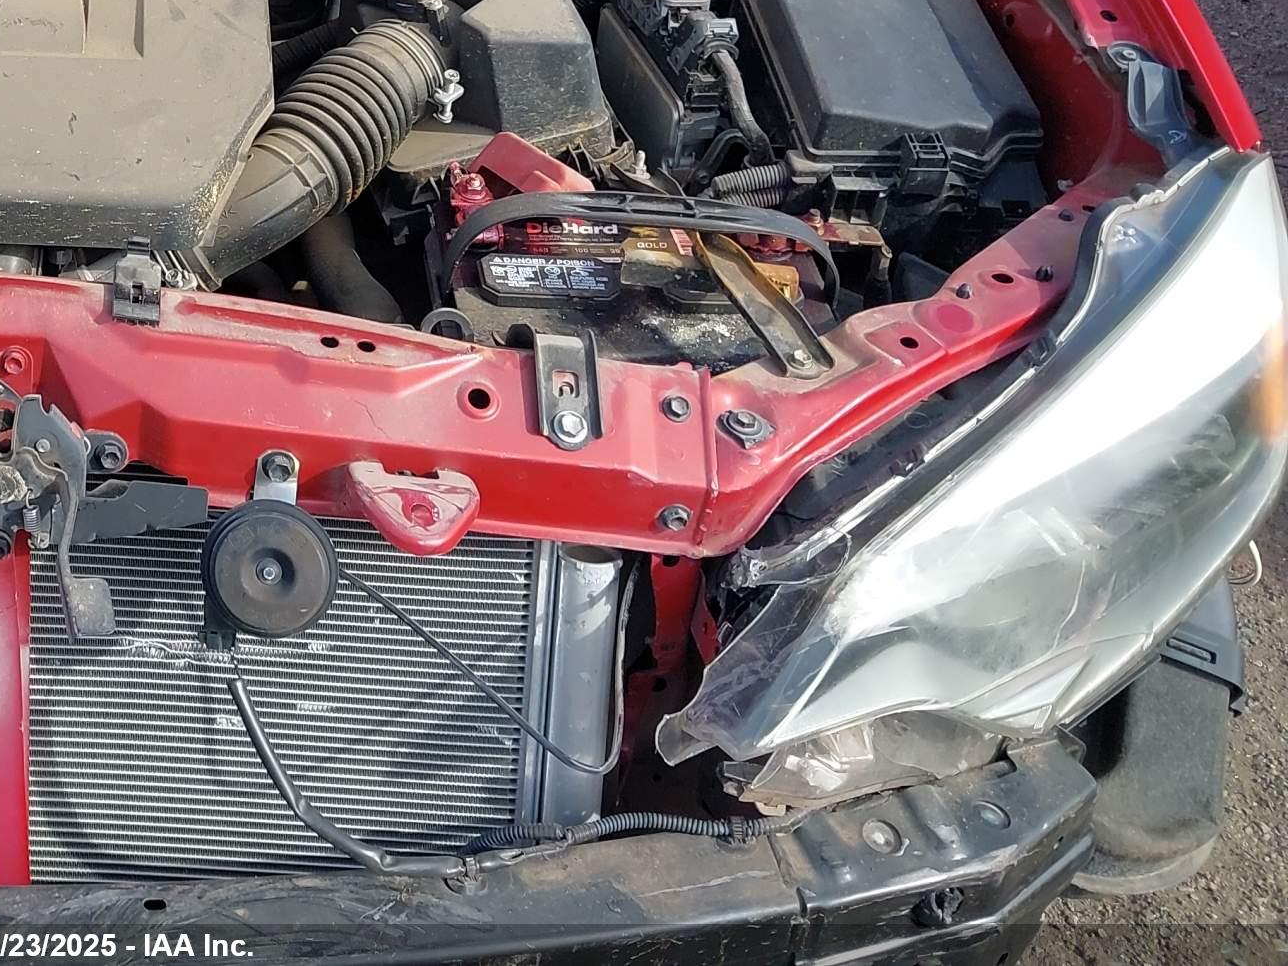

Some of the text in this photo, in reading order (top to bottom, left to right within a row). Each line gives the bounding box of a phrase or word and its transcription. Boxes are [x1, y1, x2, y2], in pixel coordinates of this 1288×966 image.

[526, 222, 618, 234] DieHard
[636, 241, 668, 249] GOLD
[557, 259, 595, 267] POISON
